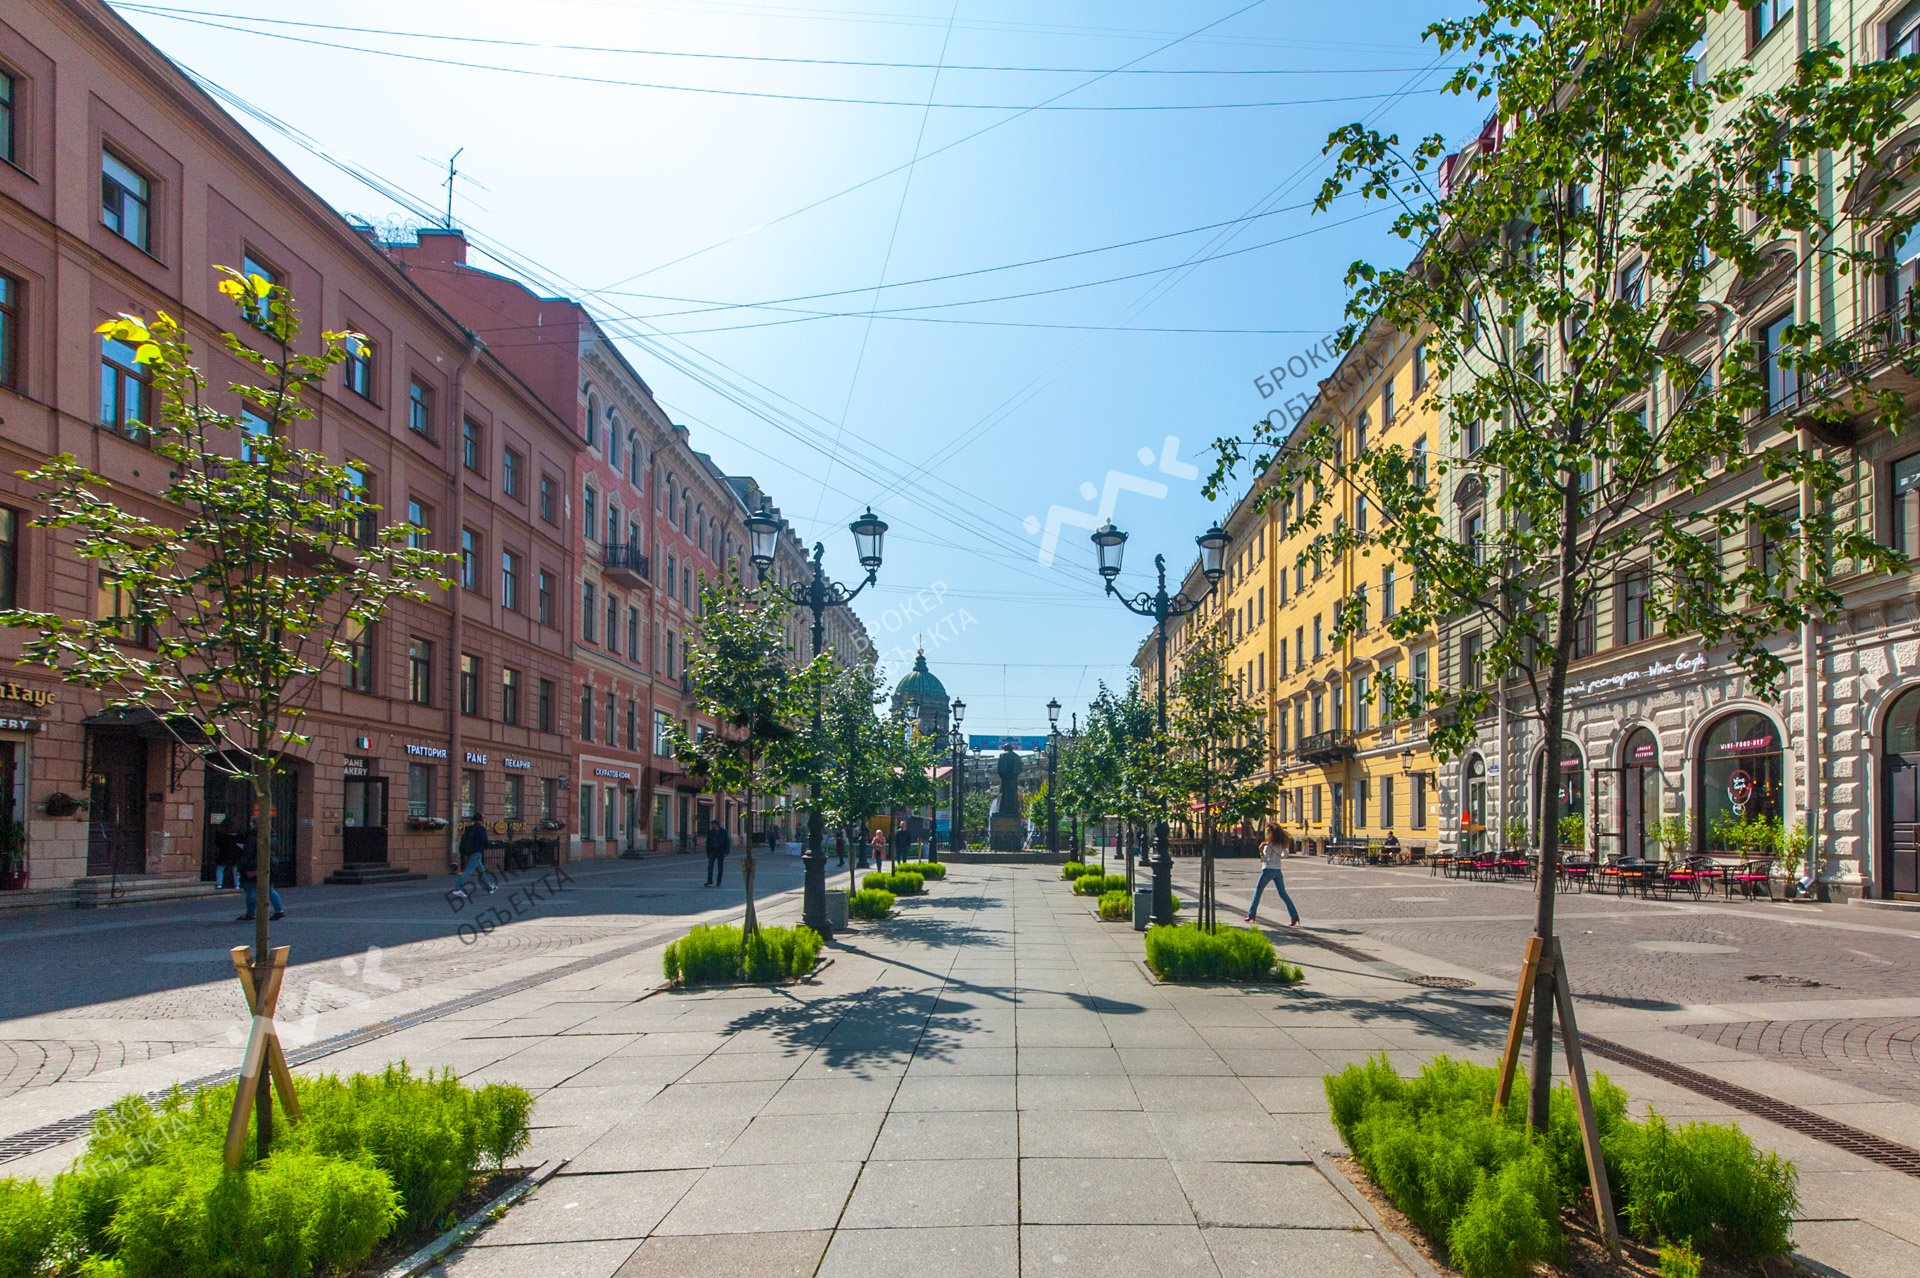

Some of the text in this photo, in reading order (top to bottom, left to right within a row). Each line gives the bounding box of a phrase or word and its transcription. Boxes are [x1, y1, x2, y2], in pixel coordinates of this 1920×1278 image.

[1649, 661, 1673, 677] Wine
[344, 757, 364, 767] PANE
[406, 744, 531, 769] ТРАТТОРИЯ PANE ПЕКАРНЯ
